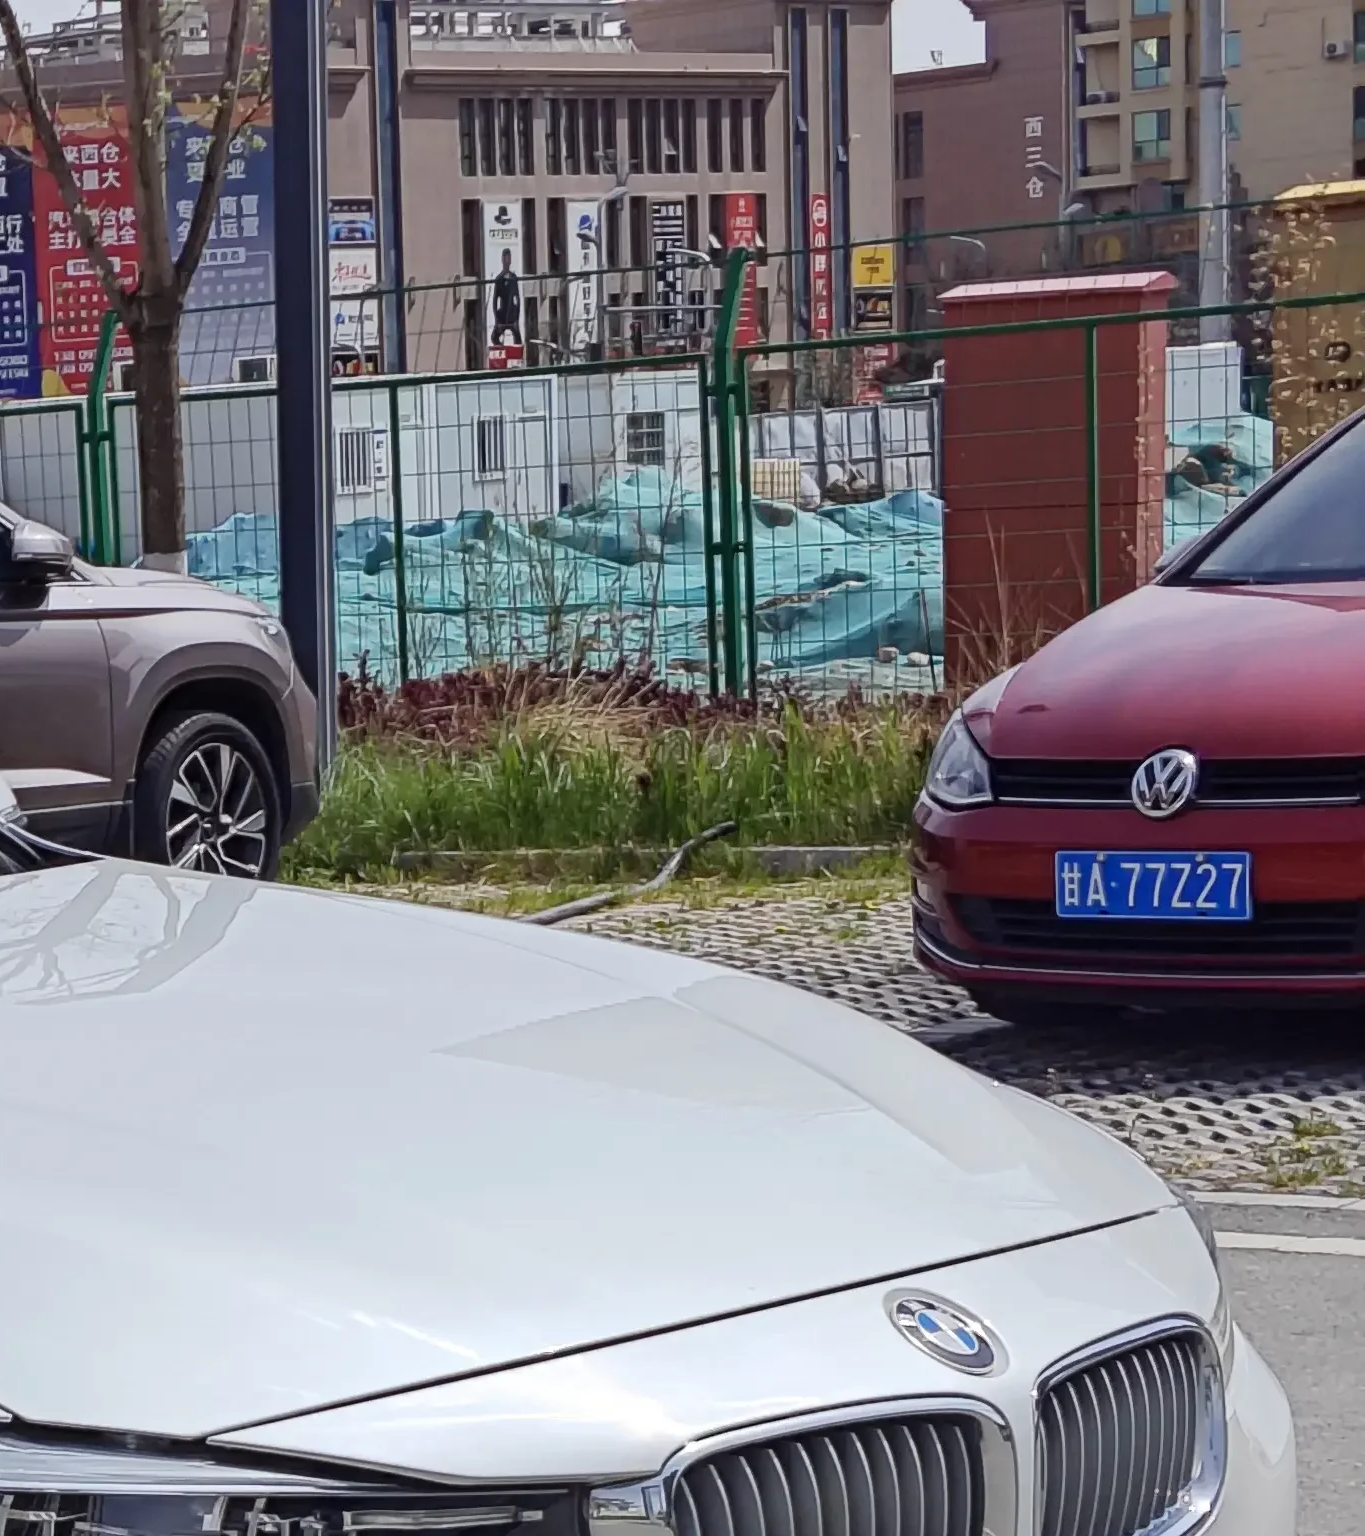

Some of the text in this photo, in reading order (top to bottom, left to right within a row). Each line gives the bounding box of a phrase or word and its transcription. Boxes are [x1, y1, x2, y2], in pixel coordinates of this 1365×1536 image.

[185, 134, 247, 161] 来仓
[1024, 116, 1044, 198] 西三仓
[186, 158, 247, 183] 更业
